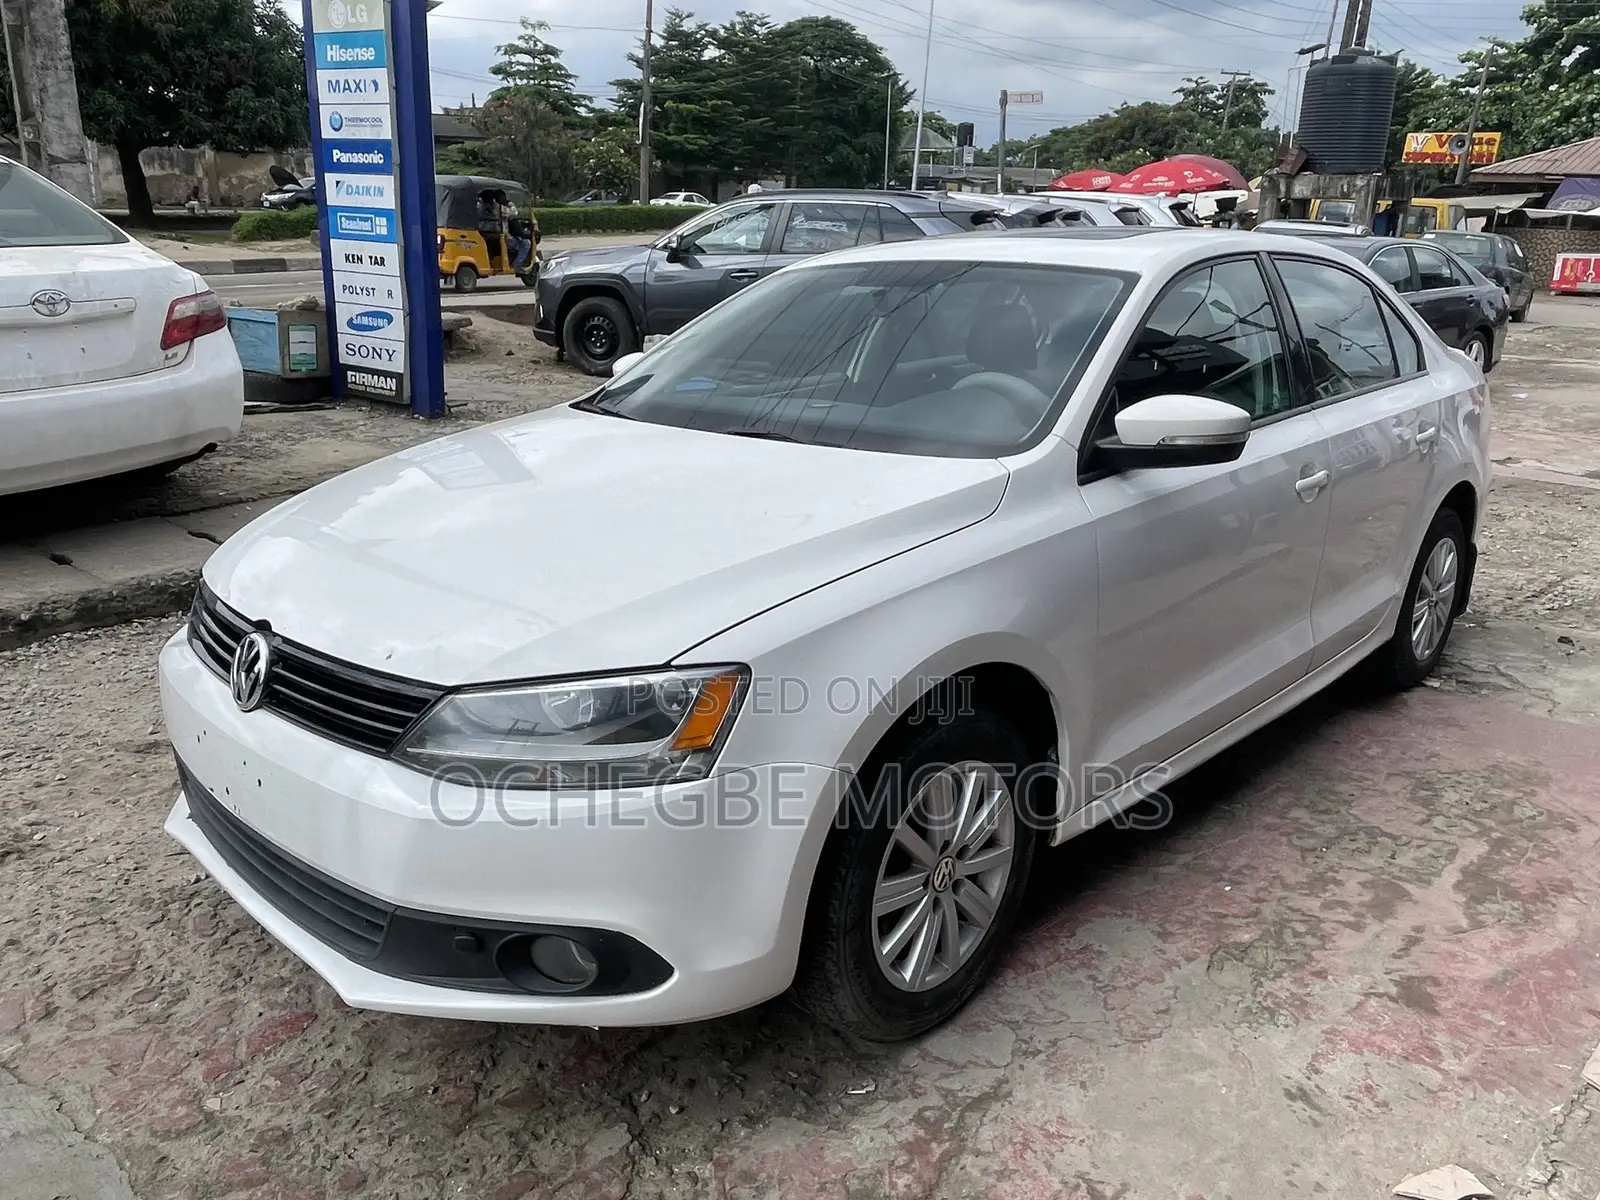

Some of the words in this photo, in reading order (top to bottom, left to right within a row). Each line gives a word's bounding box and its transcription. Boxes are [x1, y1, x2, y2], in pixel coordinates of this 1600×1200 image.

[346, 4, 368, 23] LG
[326, 44, 376, 62] Hisense
[327, 78, 367, 94] MAXI
[332, 149, 384, 164] Panasonic
[346, 184, 384, 197] DAIKIN
[344, 253, 363, 265] KEN
[368, 255, 386, 267] TAR
[342, 284, 376, 297] POLYST
[352, 315, 389, 327] SAMSUNG
[345, 342, 397, 362] SONY
[347, 371, 396, 391] FIRMAN
